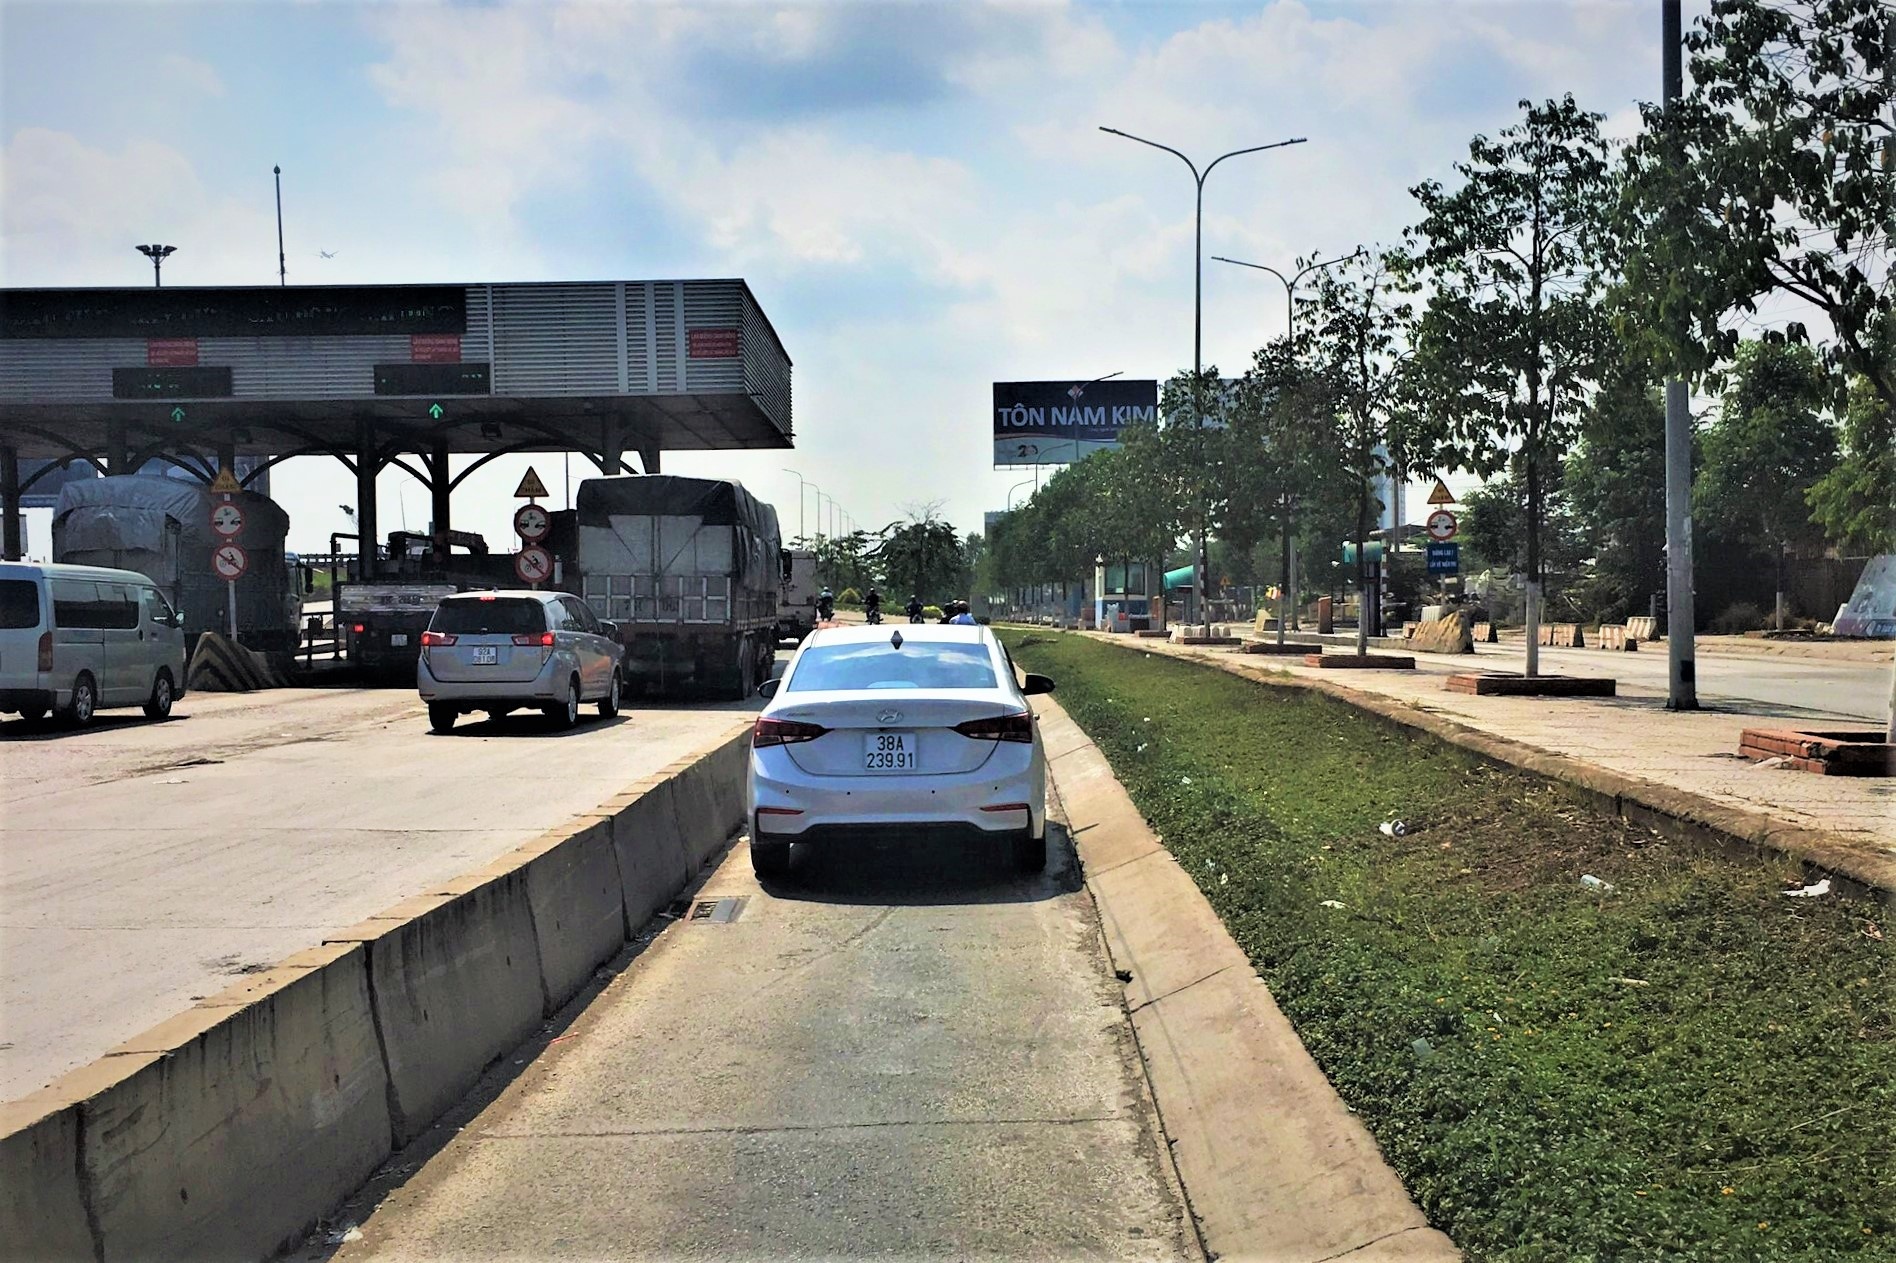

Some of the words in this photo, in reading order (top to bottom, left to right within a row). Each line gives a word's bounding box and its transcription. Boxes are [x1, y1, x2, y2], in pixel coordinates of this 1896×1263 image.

[998, 402, 1045, 427] TÔN
[1050, 406, 1106, 426] NAM
[1112, 405, 1154, 426] KIM
[877, 735, 904, 751] 38A
[866, 752, 913, 769] 239.91
